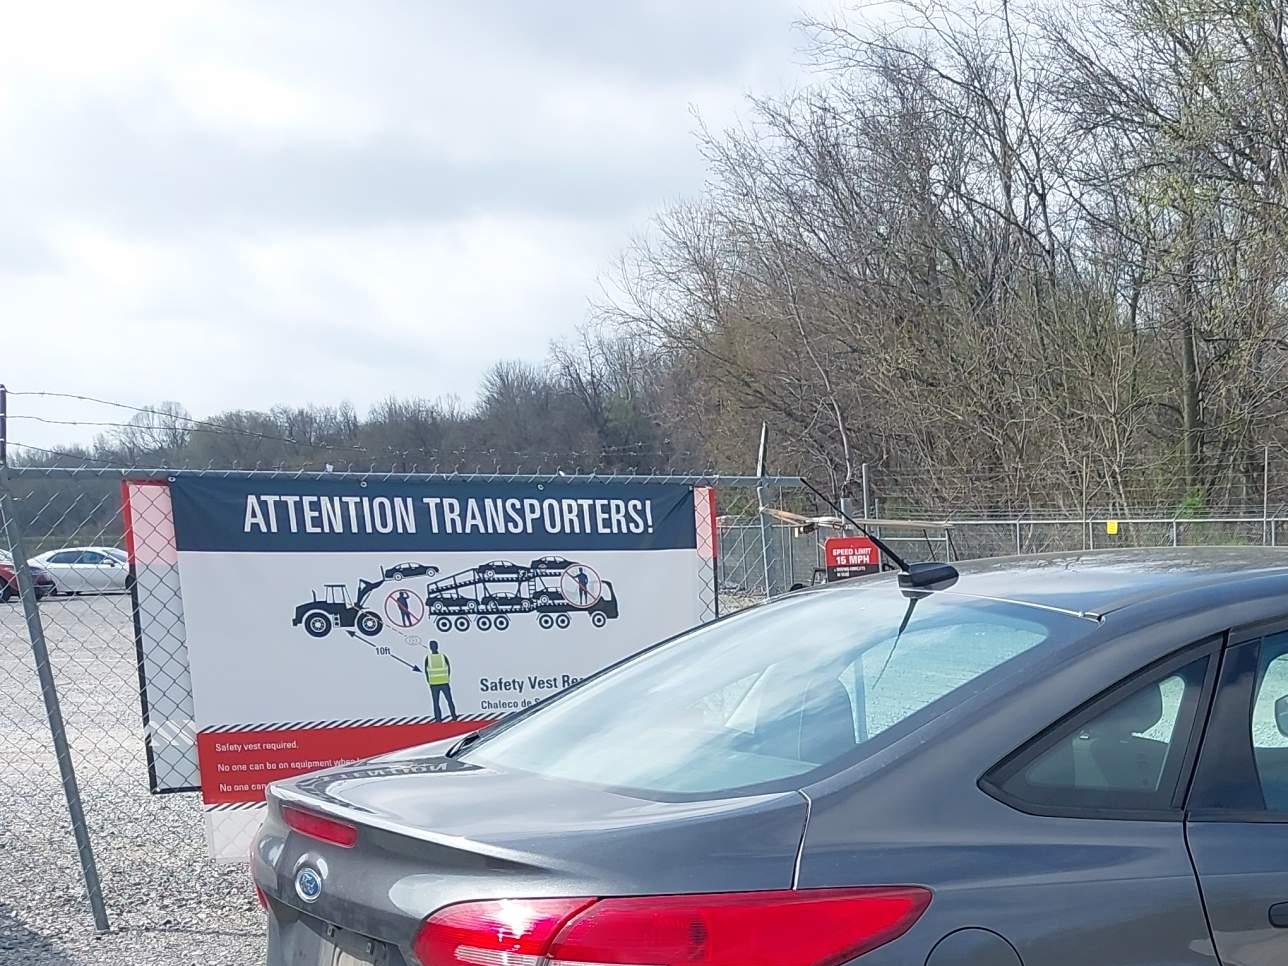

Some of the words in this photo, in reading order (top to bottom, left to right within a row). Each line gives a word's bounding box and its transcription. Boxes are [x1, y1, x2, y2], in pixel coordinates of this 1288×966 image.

[243, 494, 417, 534] ATTENTION
[422, 497, 654, 535] TRANSPORTERS!
[832, 548, 854, 556] SPEED
[854, 547, 872, 555] LIMIT
[836, 555, 847, 565] 15
[849, 555, 870, 565] MPH
[375, 646, 391, 656] 10ft
[480, 678, 524, 693] Safety
[528, 676, 558, 690] Vest
[481, 698, 519, 710] Chaleco
[215, 743, 242, 753] Safety
[243, 743, 261, 751] vest
[262, 740, 298, 751] required.
[217, 763, 230, 772] No
[249, 762, 265, 771] can
[266, 761, 277, 770] be
[291, 759, 332, 769] equipment
[219, 783, 232, 792] No
